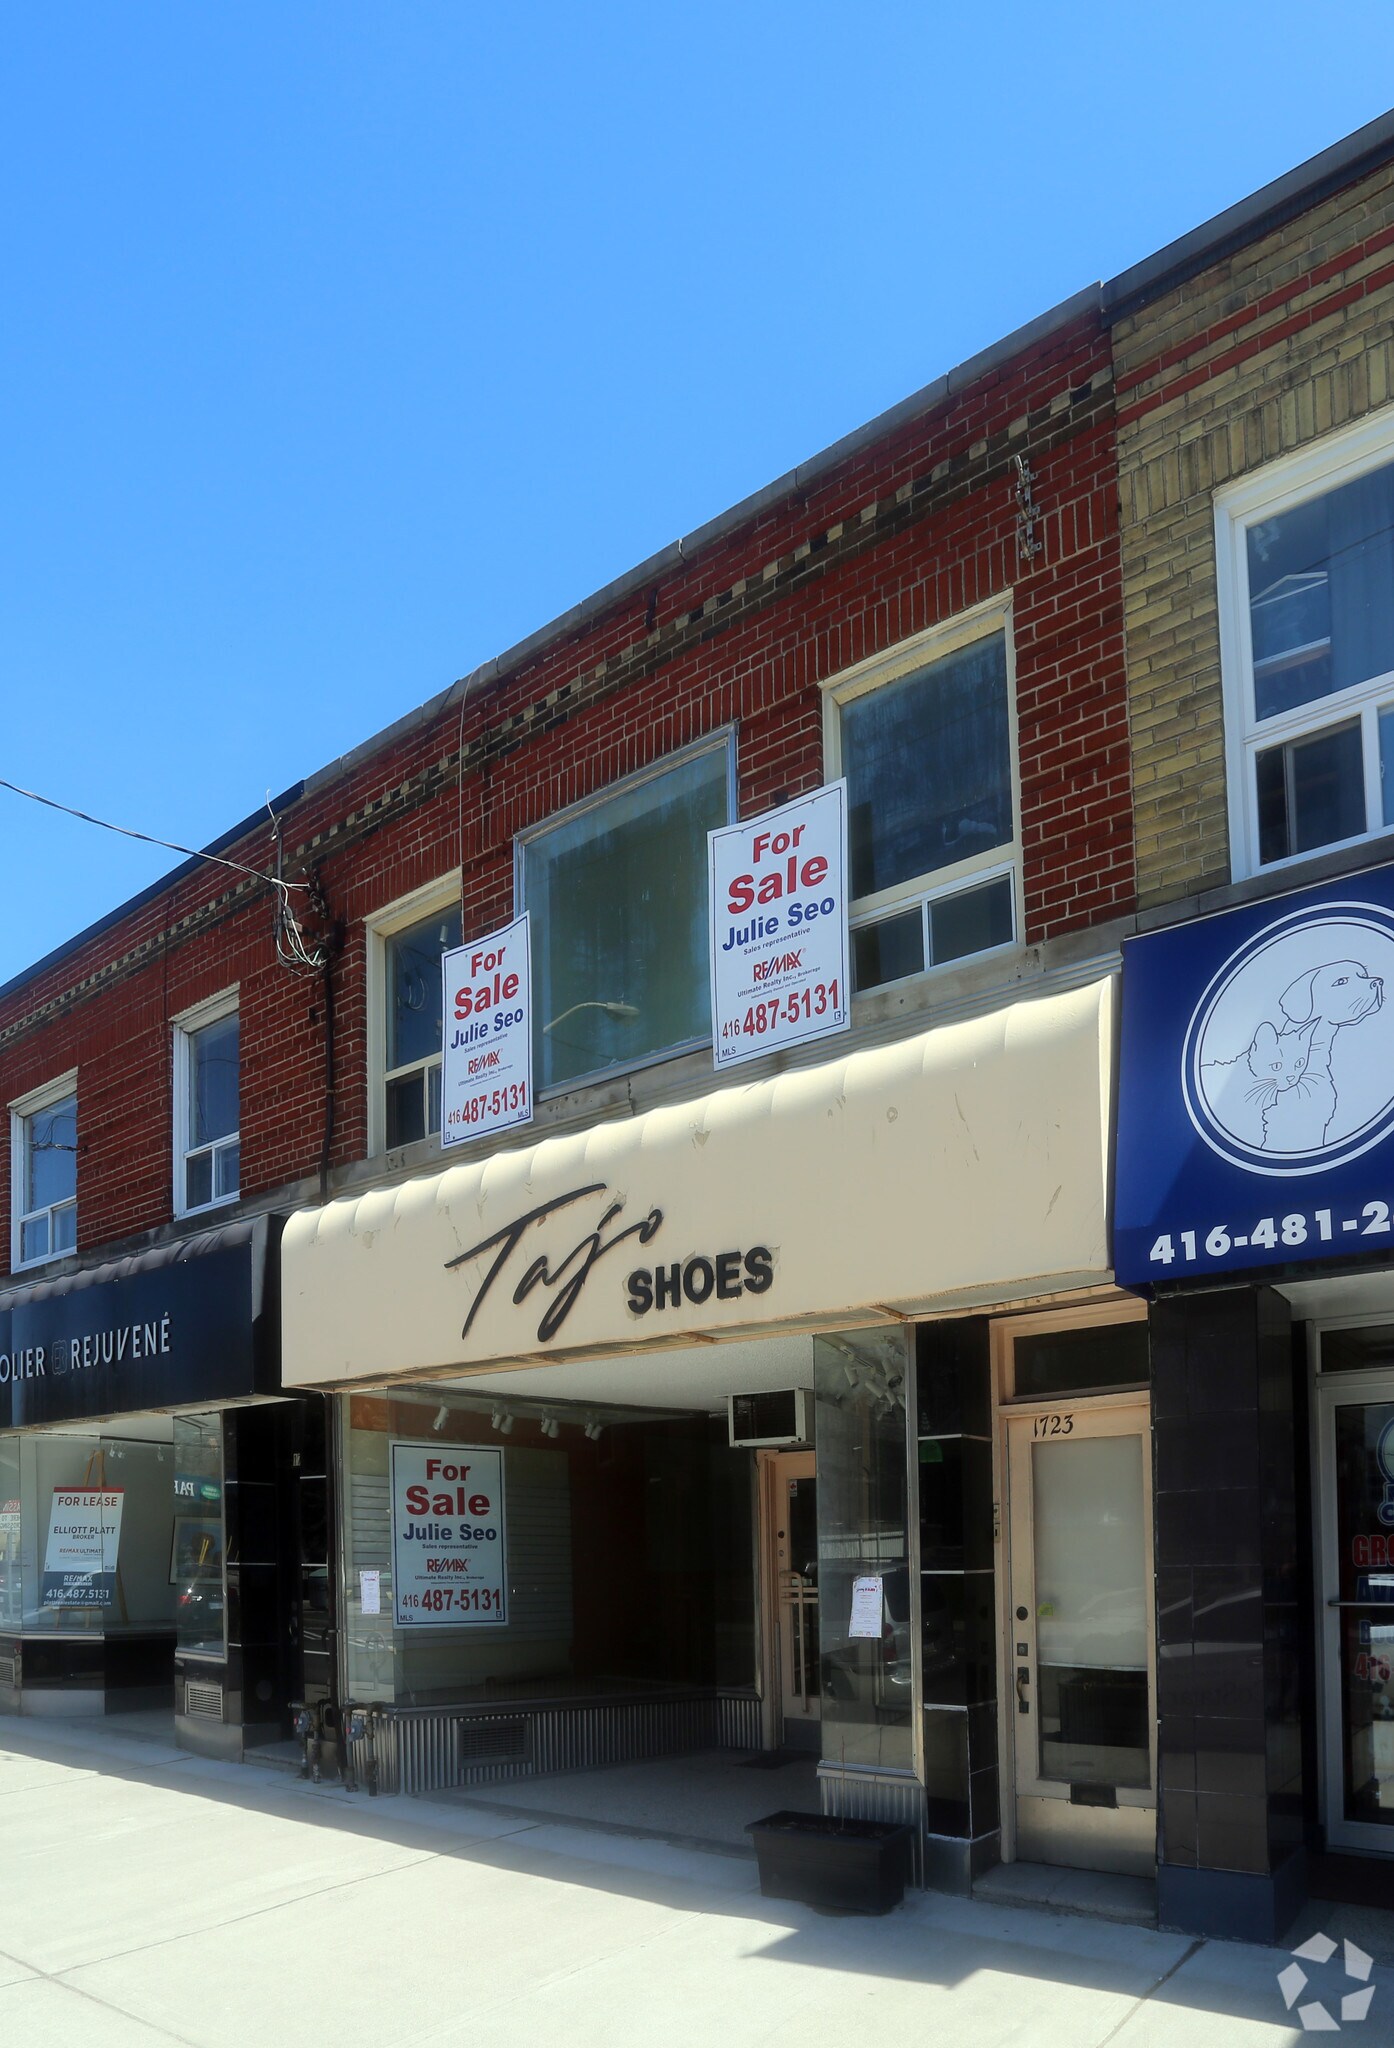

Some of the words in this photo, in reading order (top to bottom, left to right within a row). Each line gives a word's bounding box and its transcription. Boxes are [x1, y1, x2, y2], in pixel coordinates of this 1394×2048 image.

[753, 824, 806, 864] For
[727, 855, 828, 915] Sale
[722, 915, 779, 951] Julie
[788, 897, 835, 926] Seo
[743, 945, 761, 956] Sales
[762, 928, 811, 948] representative
[471, 946, 506, 978] For
[753, 949, 802, 982] RE/MAX
[454, 972, 519, 1020] Sale
[737, 986, 762, 998] Ultimate
[763, 977, 782, 988] Realty
[798, 966, 821, 977] Brokerage
[722, 1019, 740, 1039] 416
[743, 979, 838, 1037] 487-5131
[450, 1021, 488, 1050] Julie
[494, 1008, 524, 1032] Seo
[464, 1045, 476, 1054] Sales
[477, 1033, 508, 1049] representative
[468, 1049, 500, 1076] RE/MAX
[722, 1046, 736, 1058] MLS
[448, 1110, 460, 1126] 416
[462, 1080, 526, 1125] 487-5131
[518, 1109, 528, 1118] MLS
[1150, 1201, 1394, 1264] 416-481-2
[628, 1247, 773, 1314] SHOES
[0, 1346, 45, 1383] OLIER
[71, 1312, 170, 1369] REJUVENÉ
[1034, 1414, 1074, 1438] 1723
[426, 1459, 471, 1481] For
[58, 1496, 80, 1506] FOR
[83, 1496, 118, 1506] LEASE
[406, 1485, 490, 1516] Sale
[54, 1526, 87, 1534] ELLIOTT
[90, 1526, 116, 1534] PLATT
[403, 1523, 453, 1541] Julie
[459, 1524, 496, 1541] Seo
[426, 1558, 468, 1573] RE/MAX
[46, 1589, 110, 1599] 416.487.5131
[402, 1594, 418, 1608] 416
[422, 1588, 500, 1612] 487-5131
[400, 1614, 413, 1622] MLS
